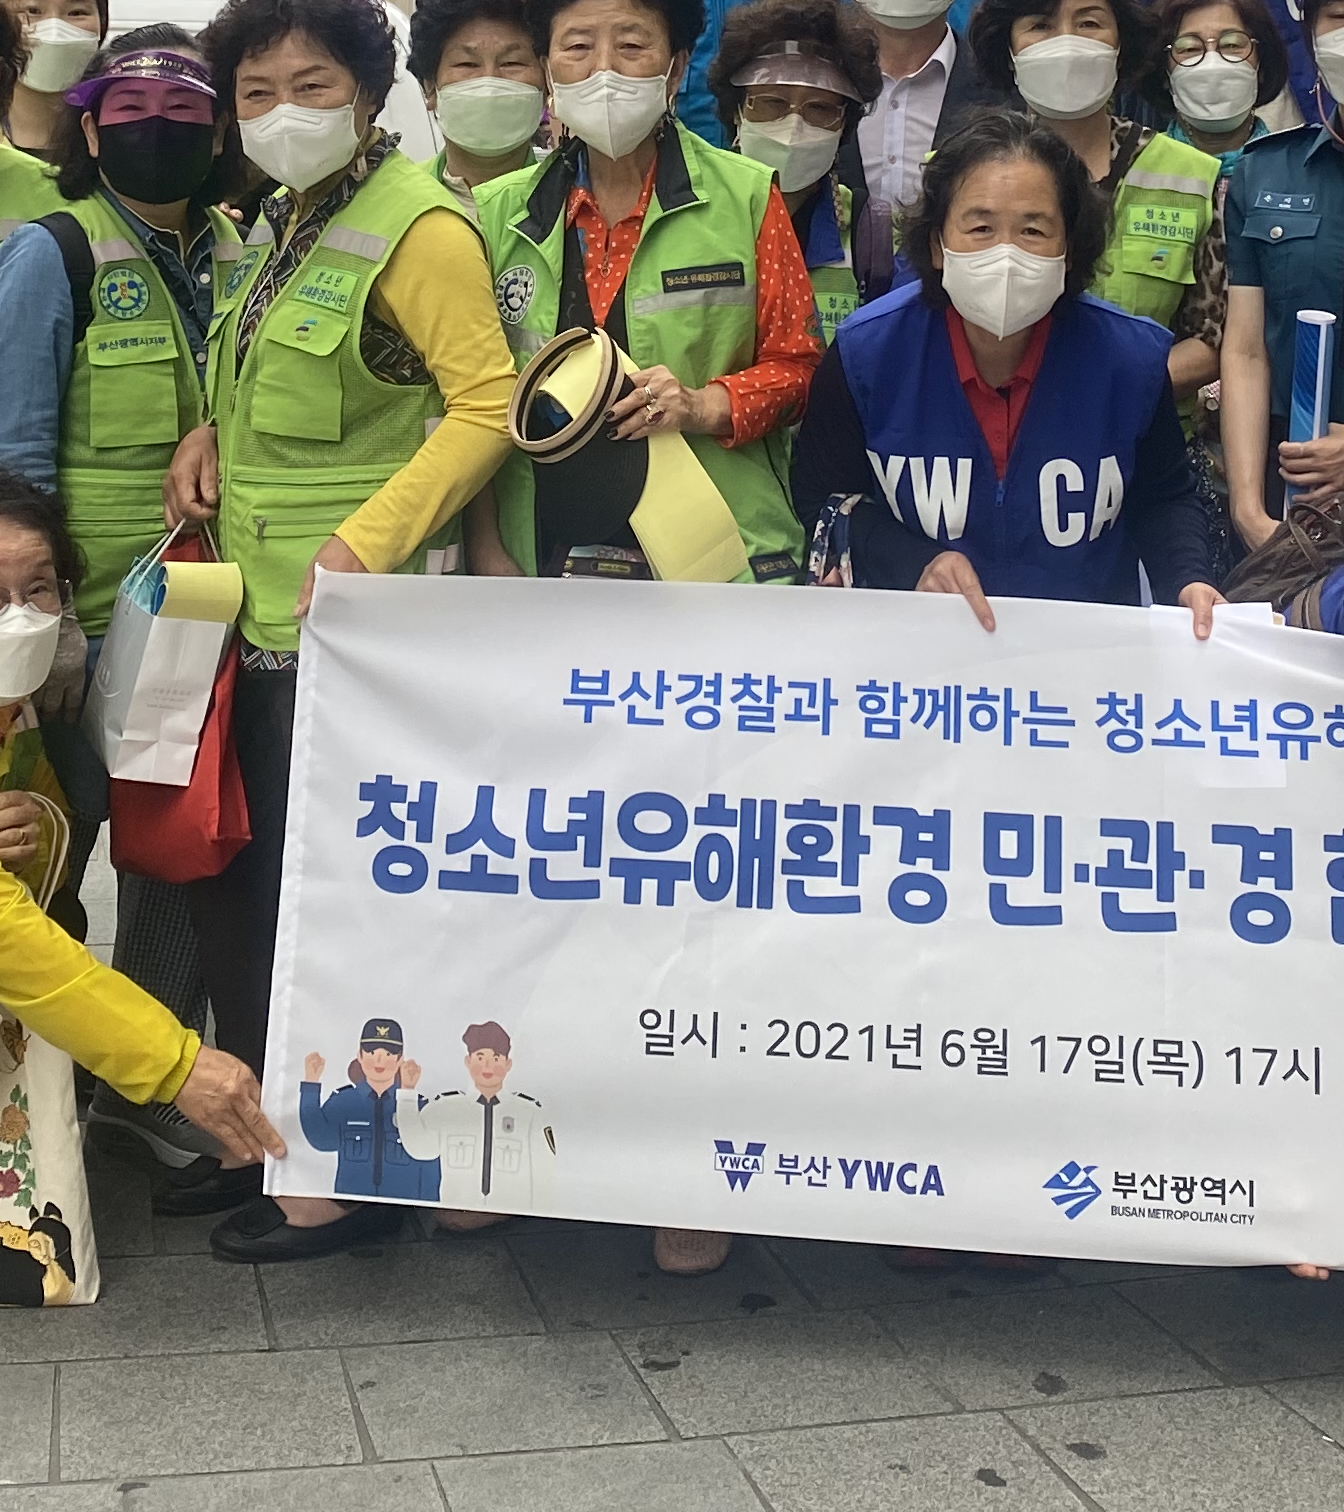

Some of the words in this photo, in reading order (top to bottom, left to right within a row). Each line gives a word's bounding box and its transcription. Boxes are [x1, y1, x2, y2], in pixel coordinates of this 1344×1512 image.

[1145, 208, 1181, 223] 청소년
[96, 335, 168, 352] 부산광역시지부
[562, 669, 838, 738] 부산경찰과
[855, 678, 1076, 751] 함께하는
[357, 774, 953, 927] 청소년유해환경
[983, 810, 1296, 945] 민·관·경
[638, 1009, 722, 1061] 일시
[765, 1016, 924, 1075] 2021년
[939, 1025, 1011, 1079] 6월
[1029, 1031, 1205, 1092] 17일(목)
[1223, 1045, 1323, 1096] 17시
[718, 1155, 761, 1172] YWCA
[775, 1152, 832, 1189] 부산
[837, 1157, 946, 1197] YWCA
[1110, 1169, 1256, 1209] 부산광역시
[1110, 1204, 1145, 1220] BUSAN
[1147, 1206, 1227, 1225] METROPOLITAN
[1230, 1212, 1256, 1227] CITY
